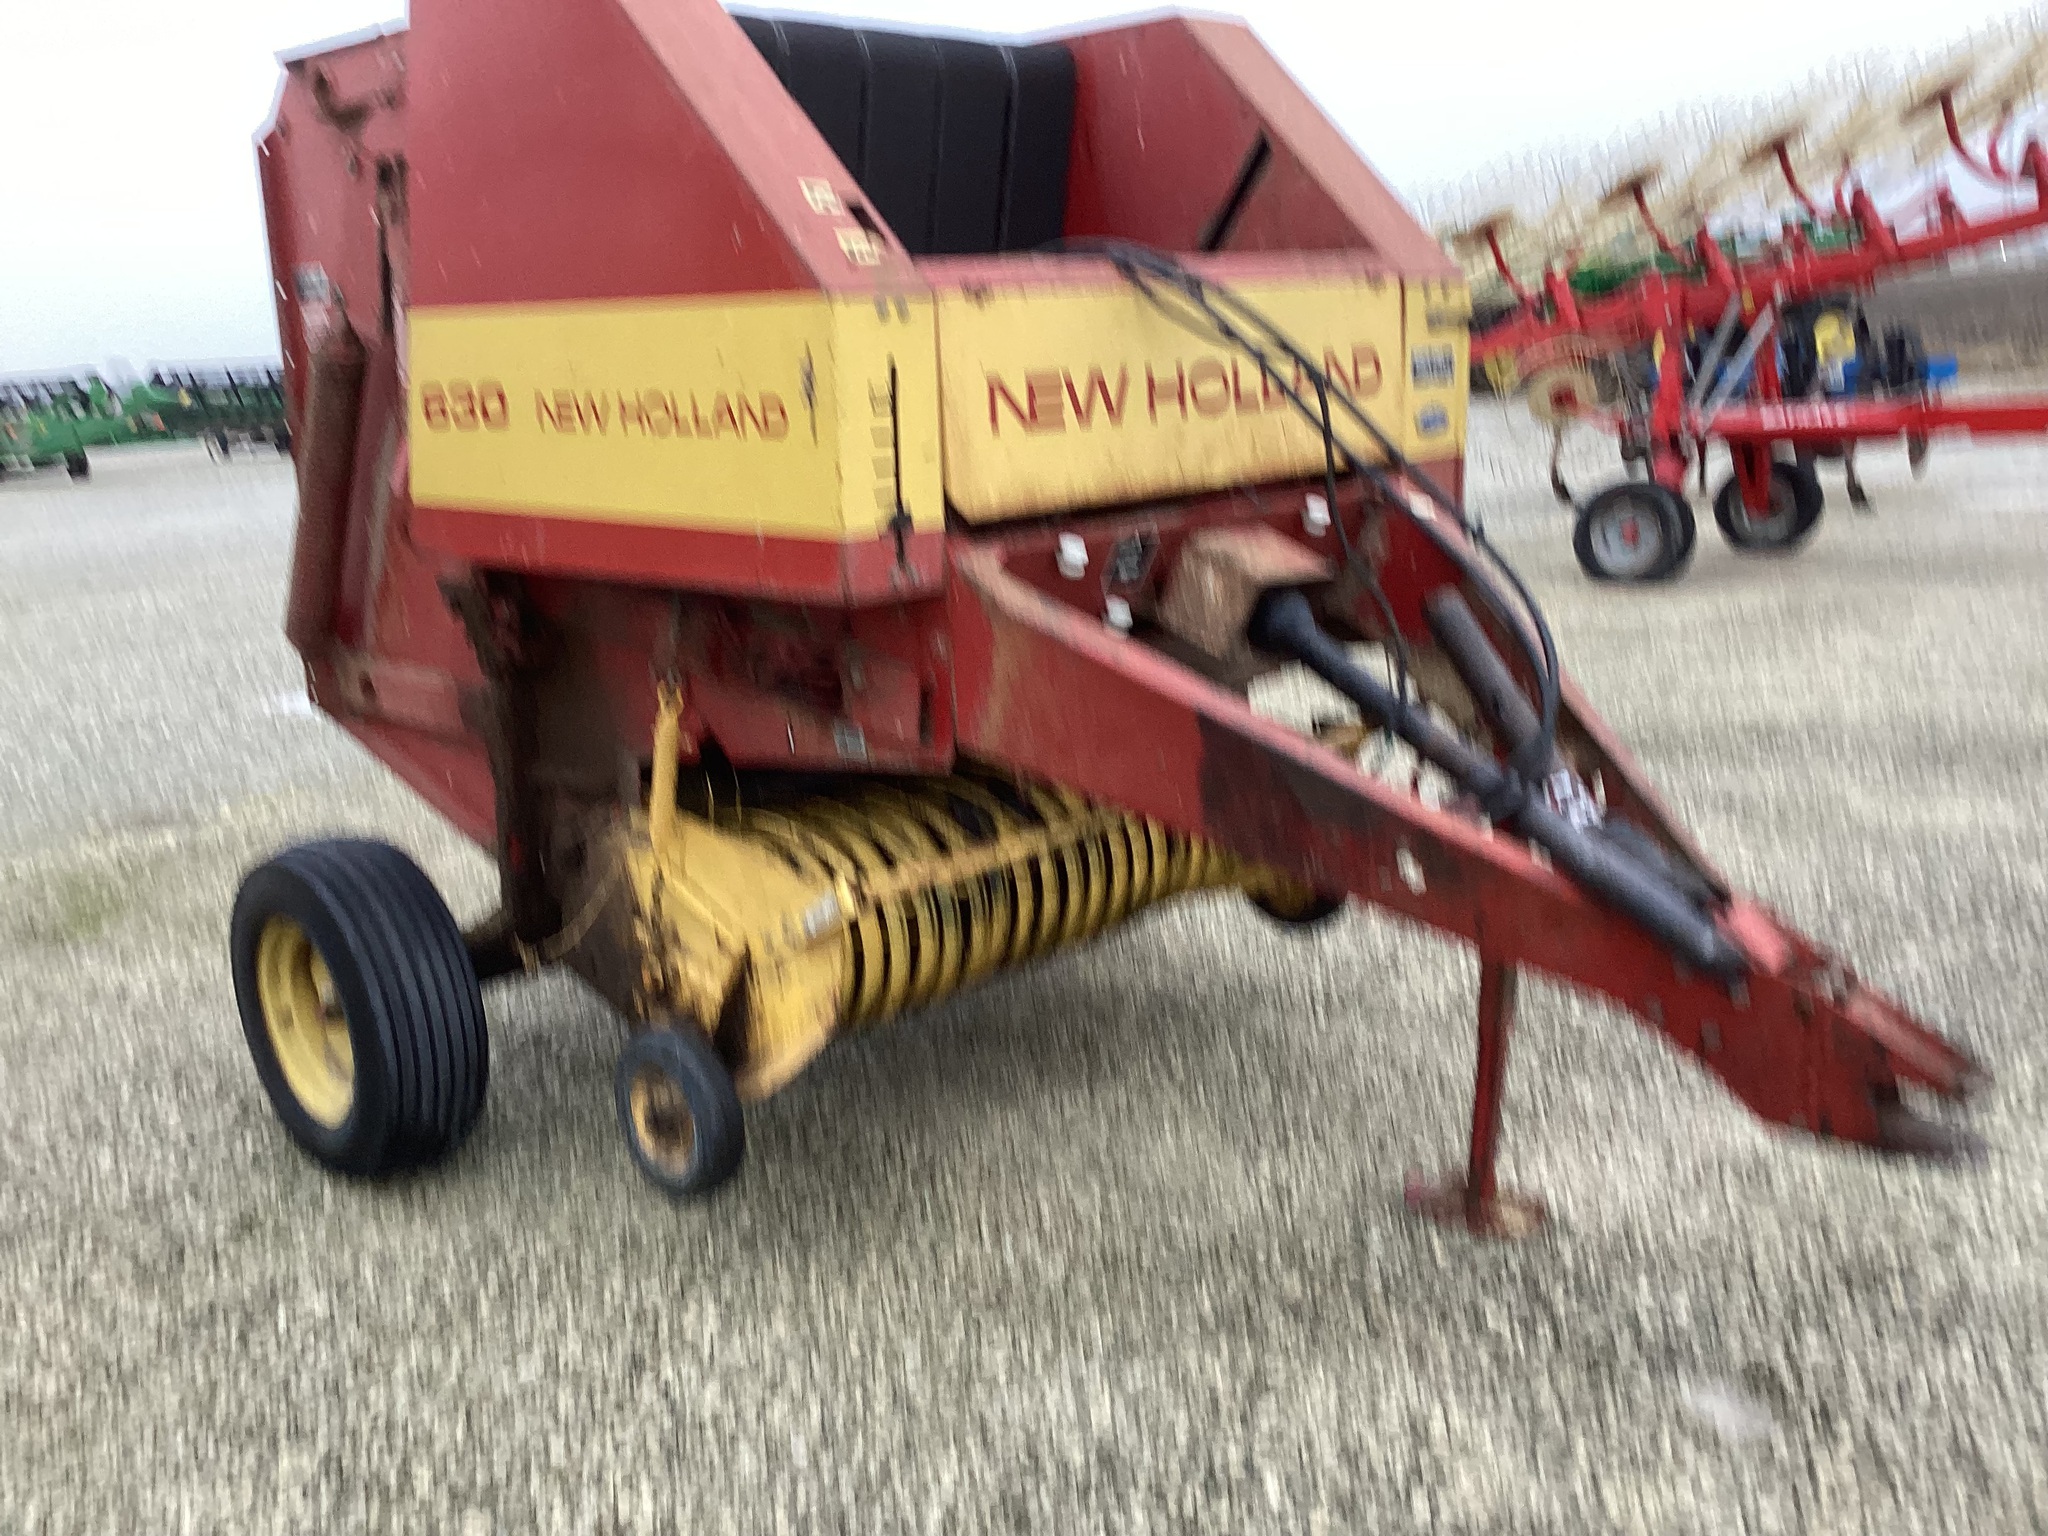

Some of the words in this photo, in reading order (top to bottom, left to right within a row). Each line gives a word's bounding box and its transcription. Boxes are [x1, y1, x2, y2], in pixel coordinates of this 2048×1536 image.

[534, 388, 609, 434] NEW
[617, 389, 790, 441] HOLLAND
[987, 361, 1129, 436] NEW
[1145, 341, 1383, 425] HOLLAND
